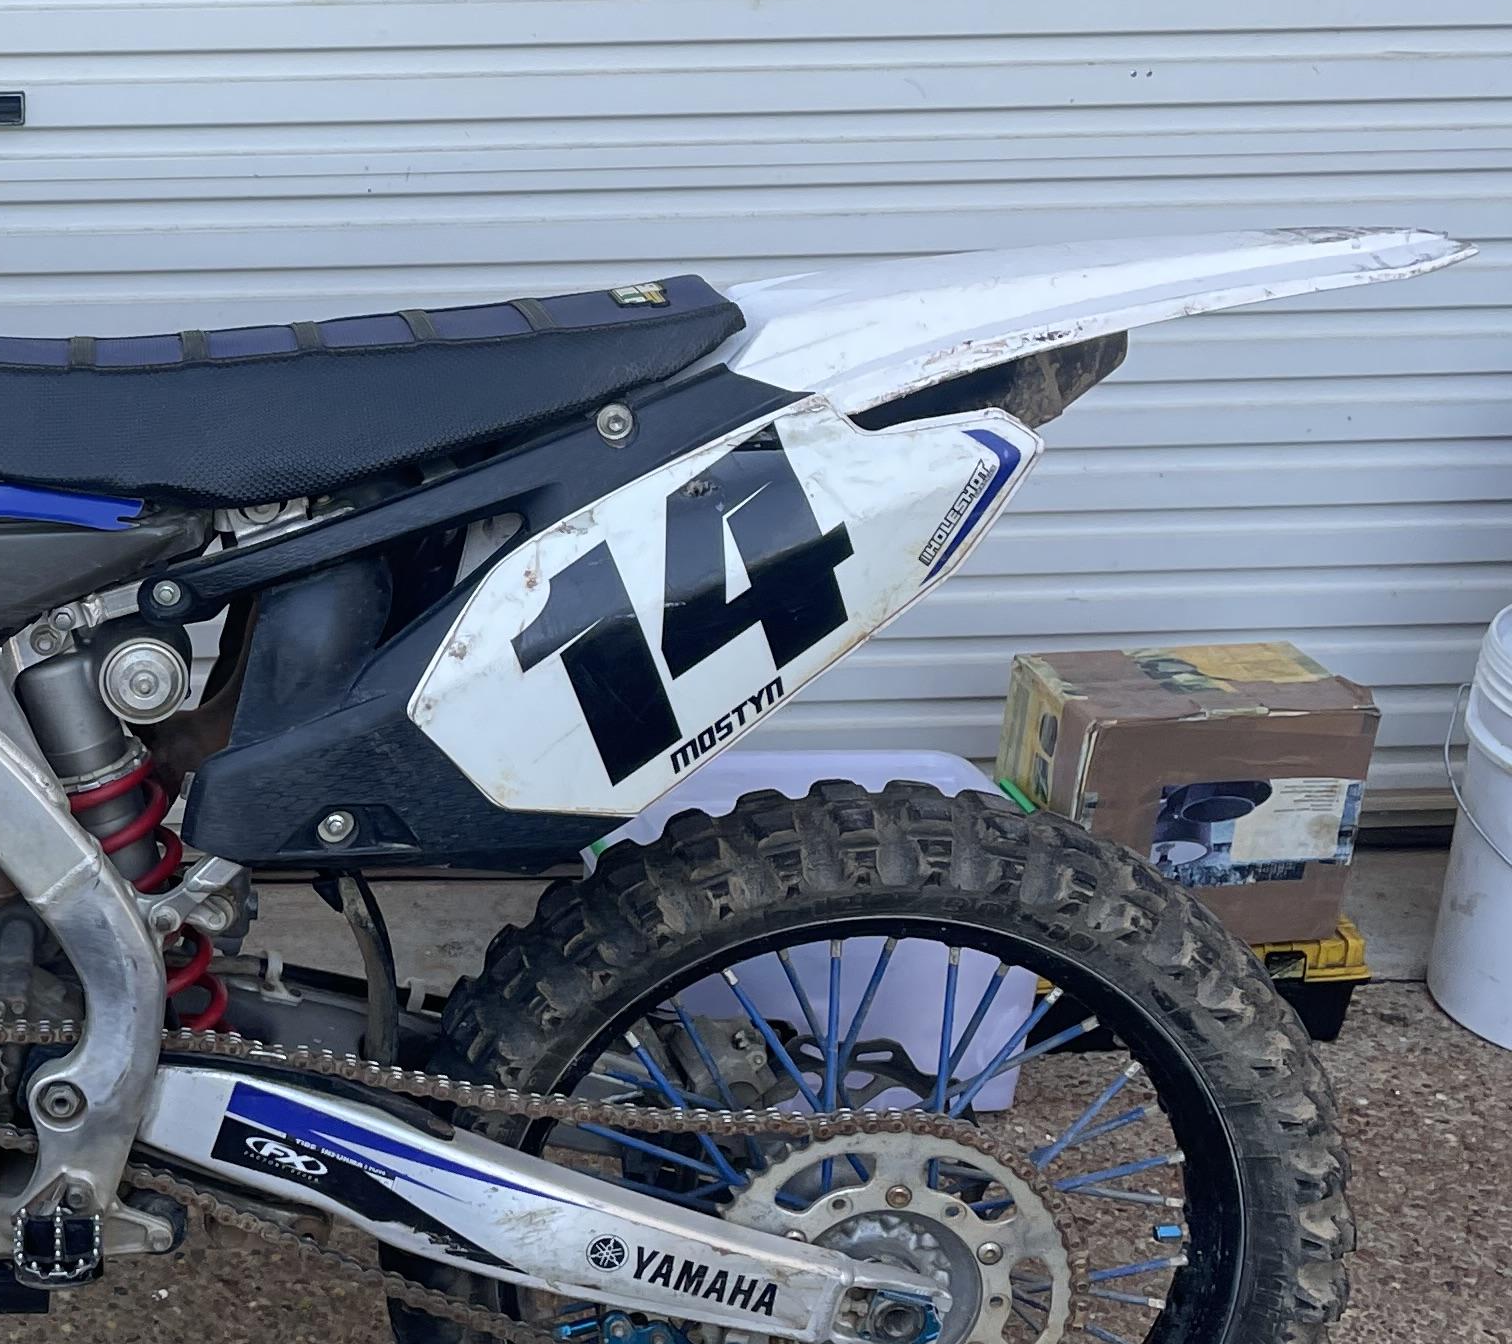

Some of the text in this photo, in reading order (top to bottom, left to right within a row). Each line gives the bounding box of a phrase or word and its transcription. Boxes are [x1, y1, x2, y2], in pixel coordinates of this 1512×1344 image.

[921, 458, 989, 564] HOLESHOT
[511, 423, 854, 787] 14
[670, 676, 785, 774] MOSTYN
[632, 1245, 779, 1317] YAMAHA
